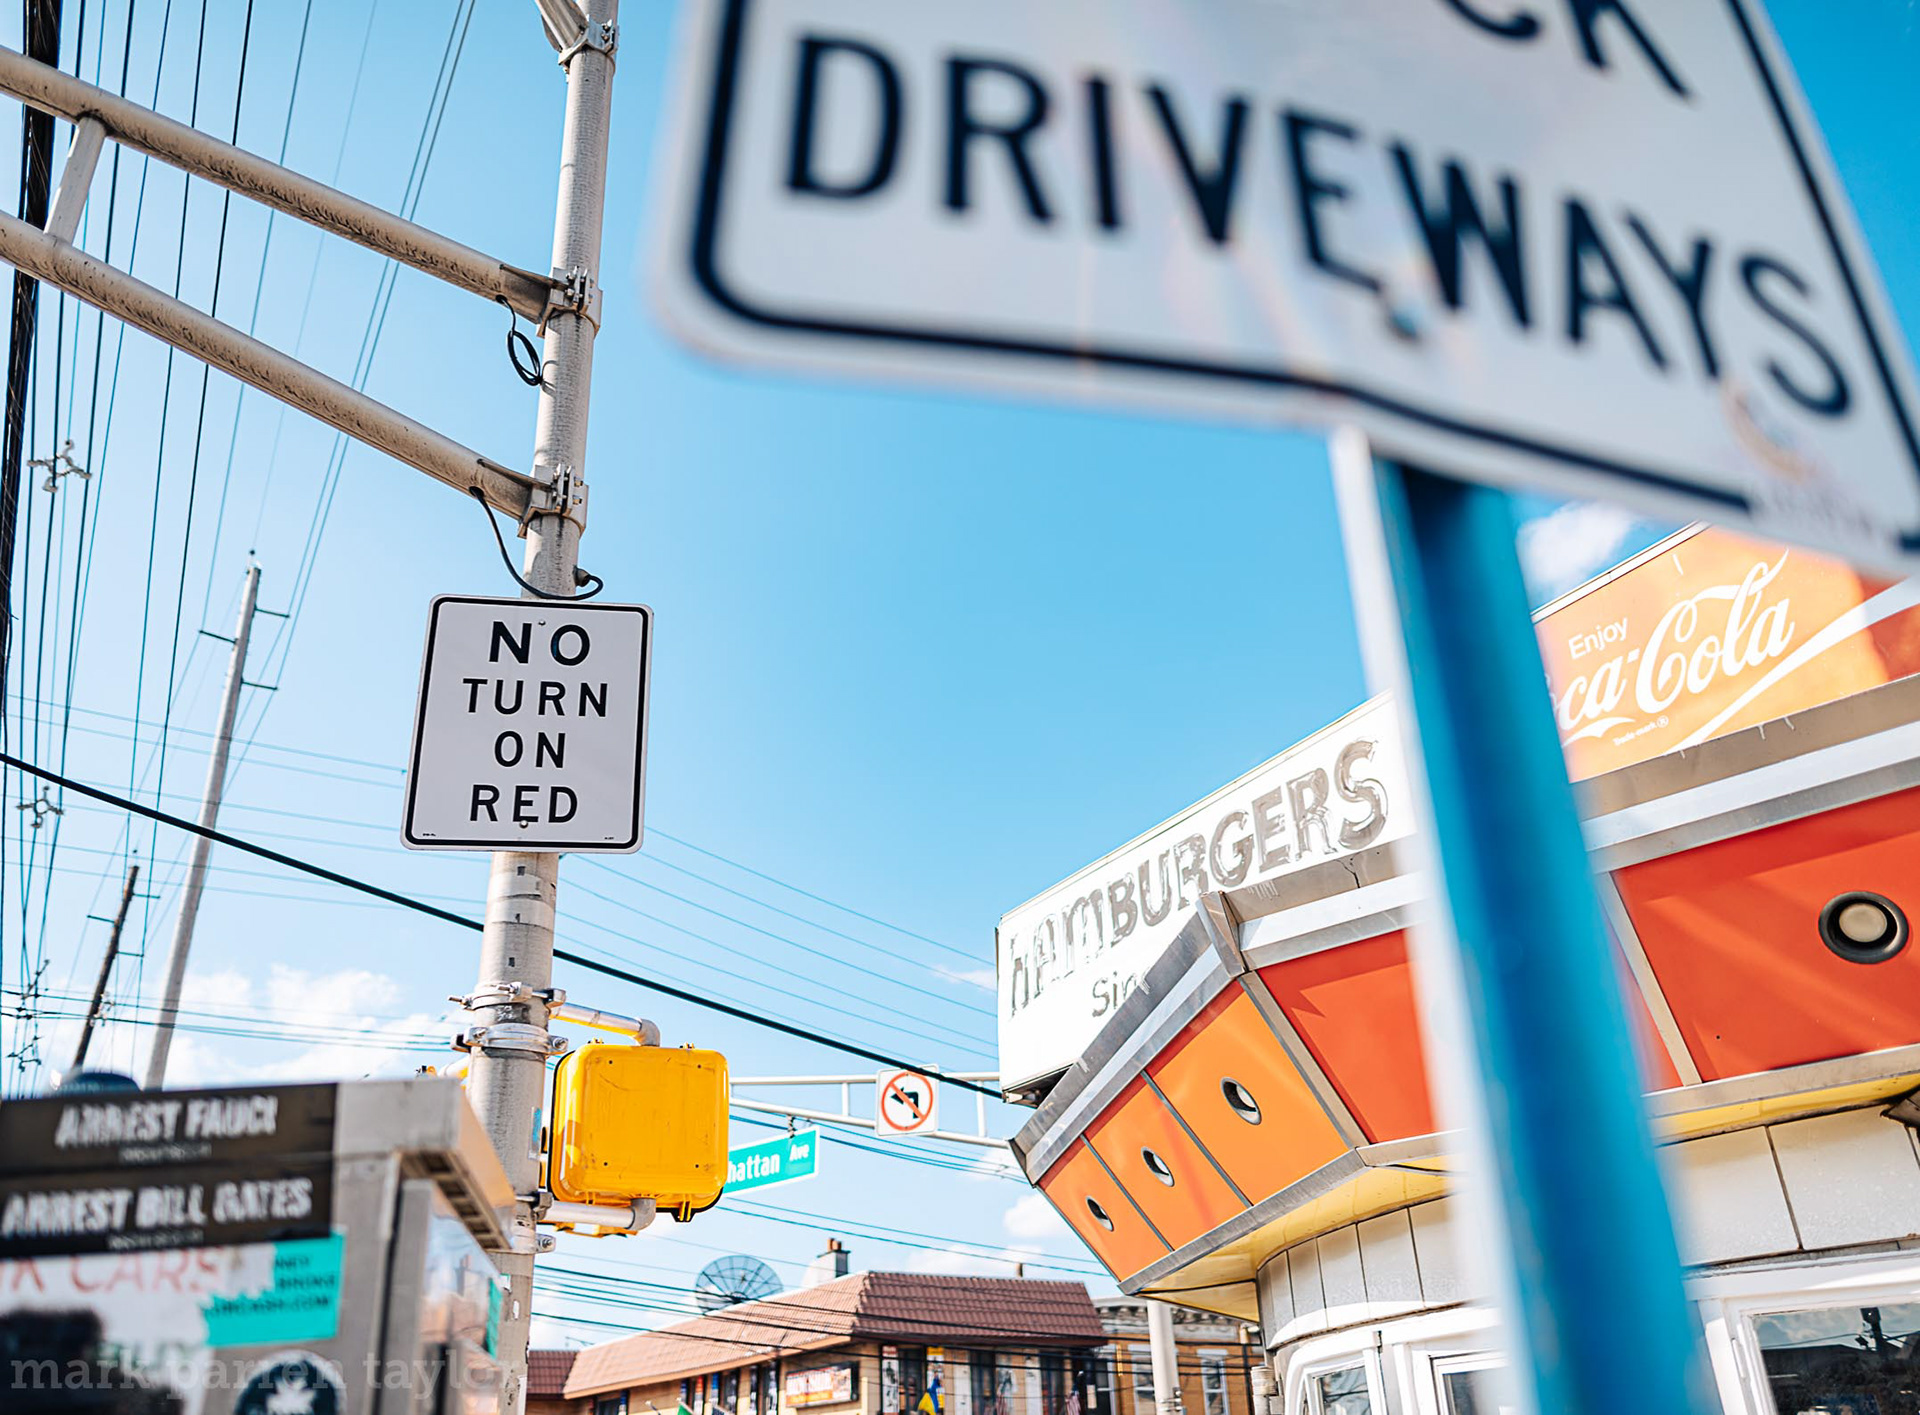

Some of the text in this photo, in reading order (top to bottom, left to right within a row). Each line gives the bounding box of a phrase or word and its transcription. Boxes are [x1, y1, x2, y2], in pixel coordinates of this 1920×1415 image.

[785, 36, 1850, 418] DRIVEWAYS
[489, 621, 590, 666] NO
[1568, 616, 1628, 660] Enjoy
[463, 678, 607, 717] TURN
[494, 731, 565, 768] ON
[470, 784, 578, 823] RED
[1009, 736, 1389, 1018] HAMBURGERS
[1092, 969, 1140, 1018] Sin
[55, 1095, 279, 1148] ARREST FAUCI
[727, 1143, 811, 1184] hattan Ave
[1, 1176, 313, 1238] ARREST BILL GATES
